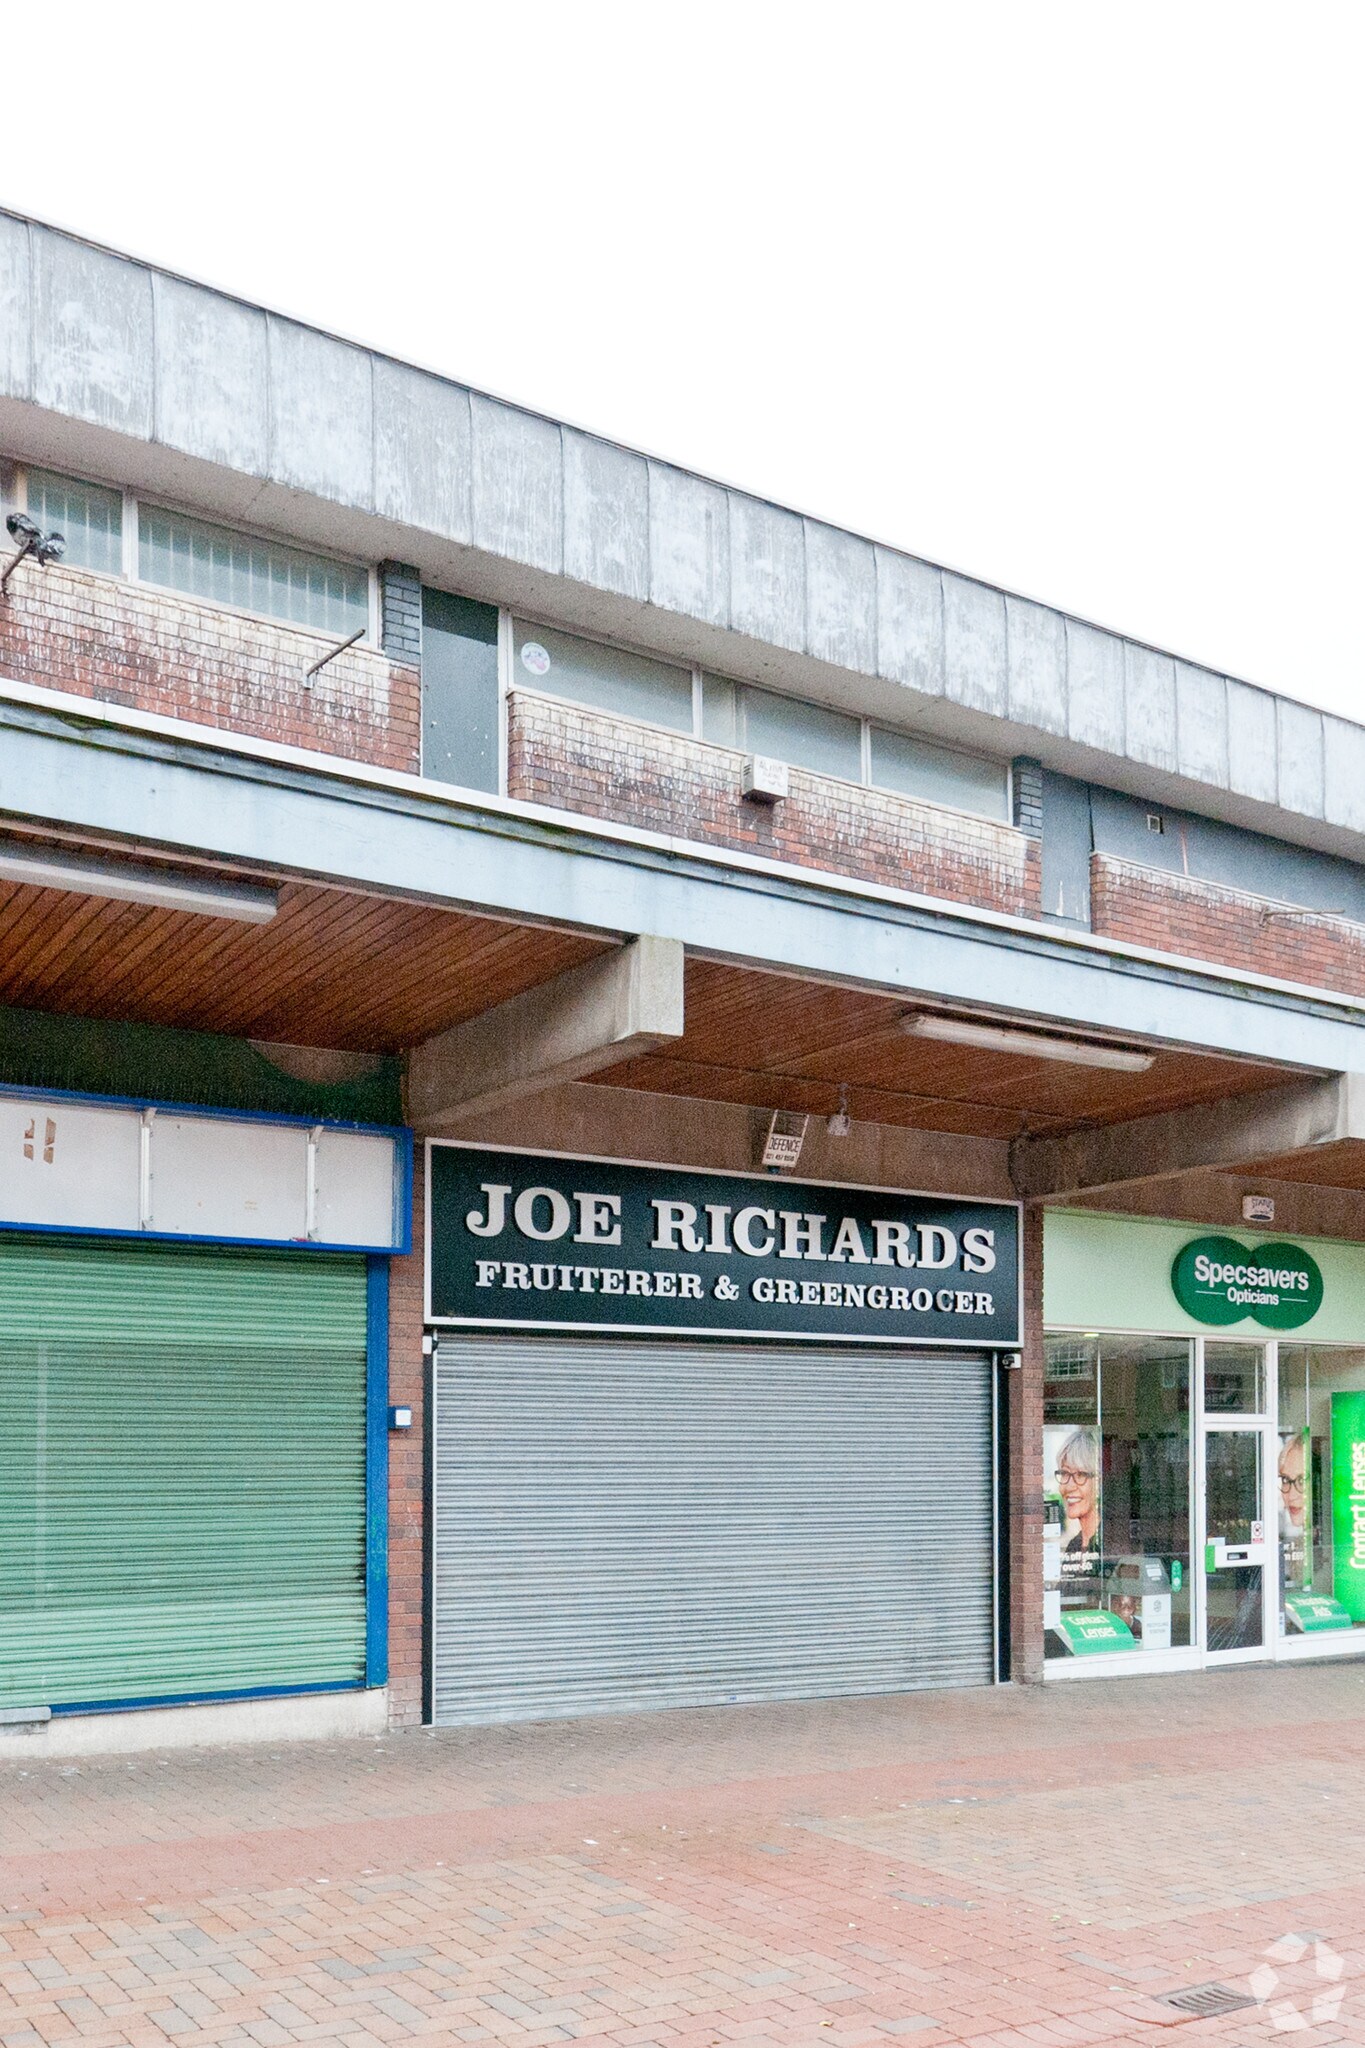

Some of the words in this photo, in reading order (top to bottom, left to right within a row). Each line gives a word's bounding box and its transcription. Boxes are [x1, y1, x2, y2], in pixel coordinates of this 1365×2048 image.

[768, 1137, 801, 1152] DEFENCE
[466, 1183, 622, 1246] JOE
[651, 1199, 996, 1275] RICHARDS
[1194, 1255, 1309, 1291] Specsavers
[475, 1260, 704, 1300] FRUITERER
[714, 1275, 740, 1301] &
[752, 1277, 996, 1316] GREENGROCER
[1227, 1287, 1279, 1305] Opticians
[1067, 1615, 1110, 1625] Contact
[1080, 1626, 1117, 1639] Lenses
